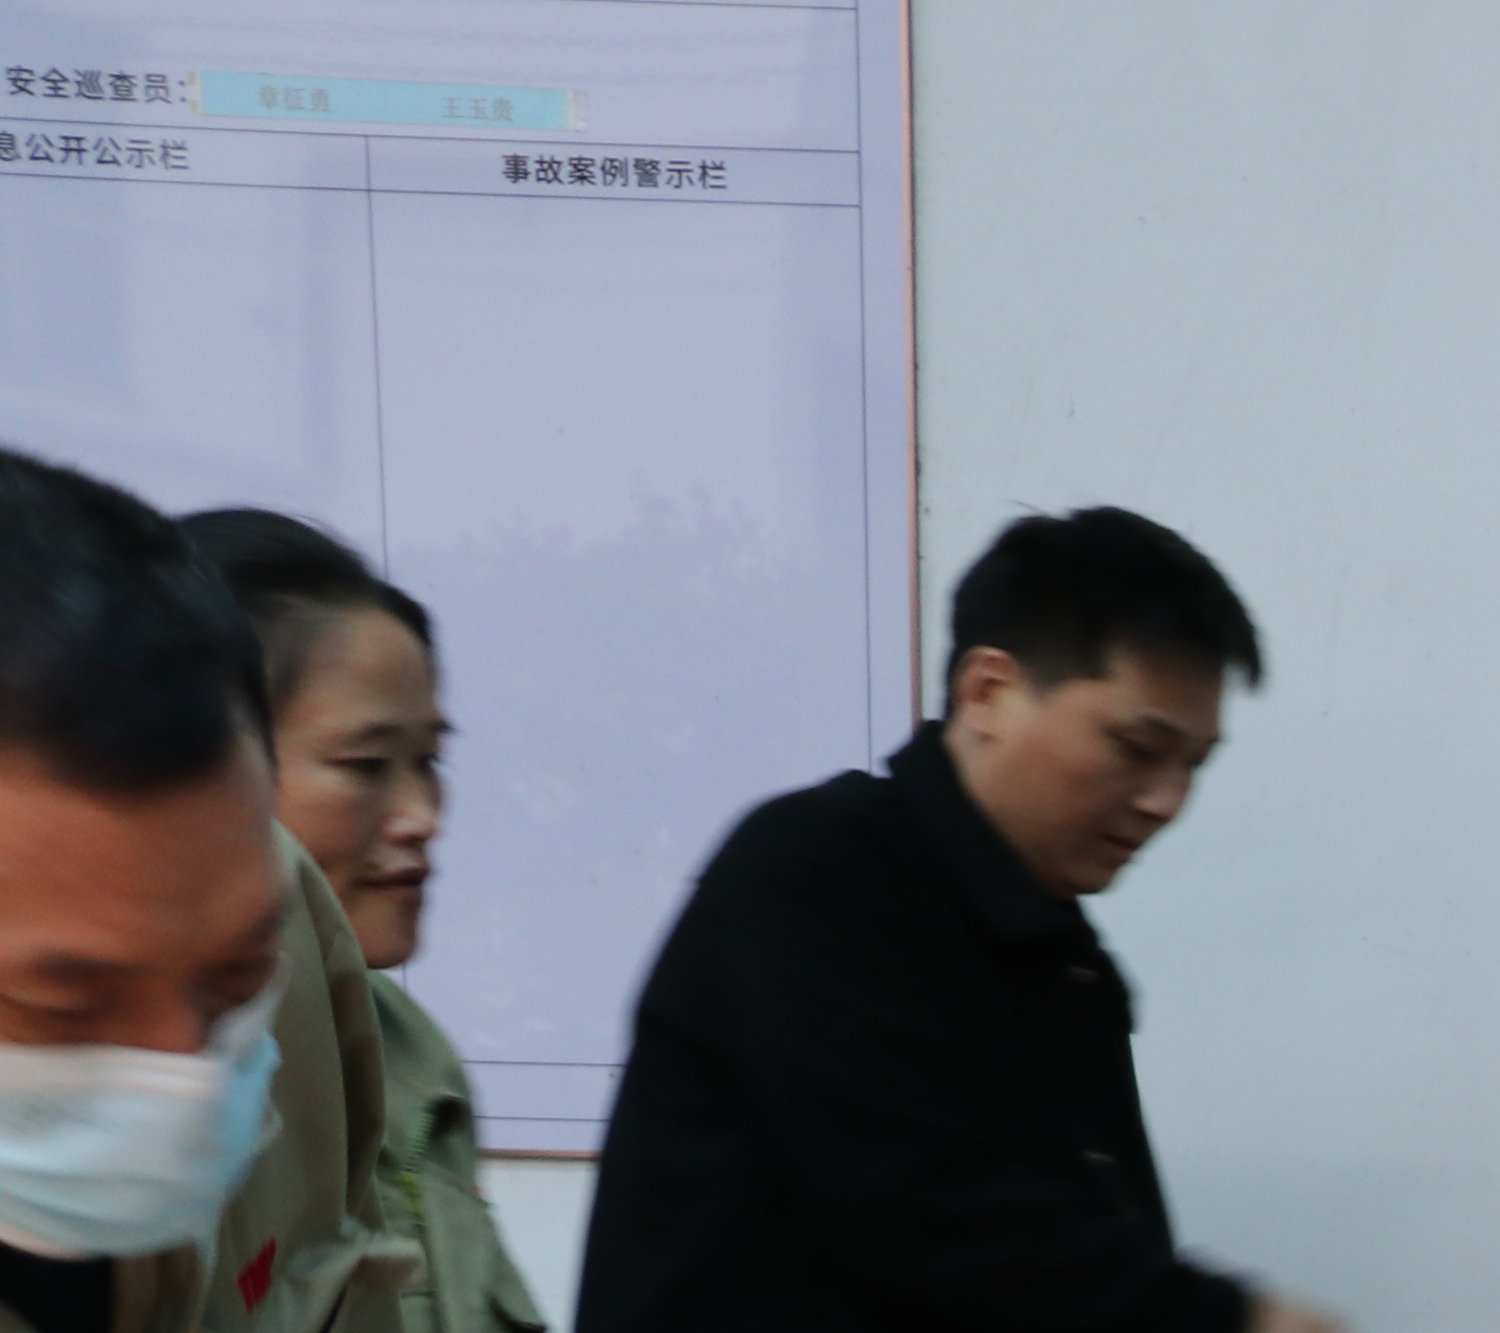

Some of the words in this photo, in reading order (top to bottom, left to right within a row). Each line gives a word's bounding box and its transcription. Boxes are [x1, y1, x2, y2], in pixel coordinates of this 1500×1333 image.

[6, 66, 187, 104] 安全巡查员：
[503, 154, 728, 189] 事故案例警示栏
